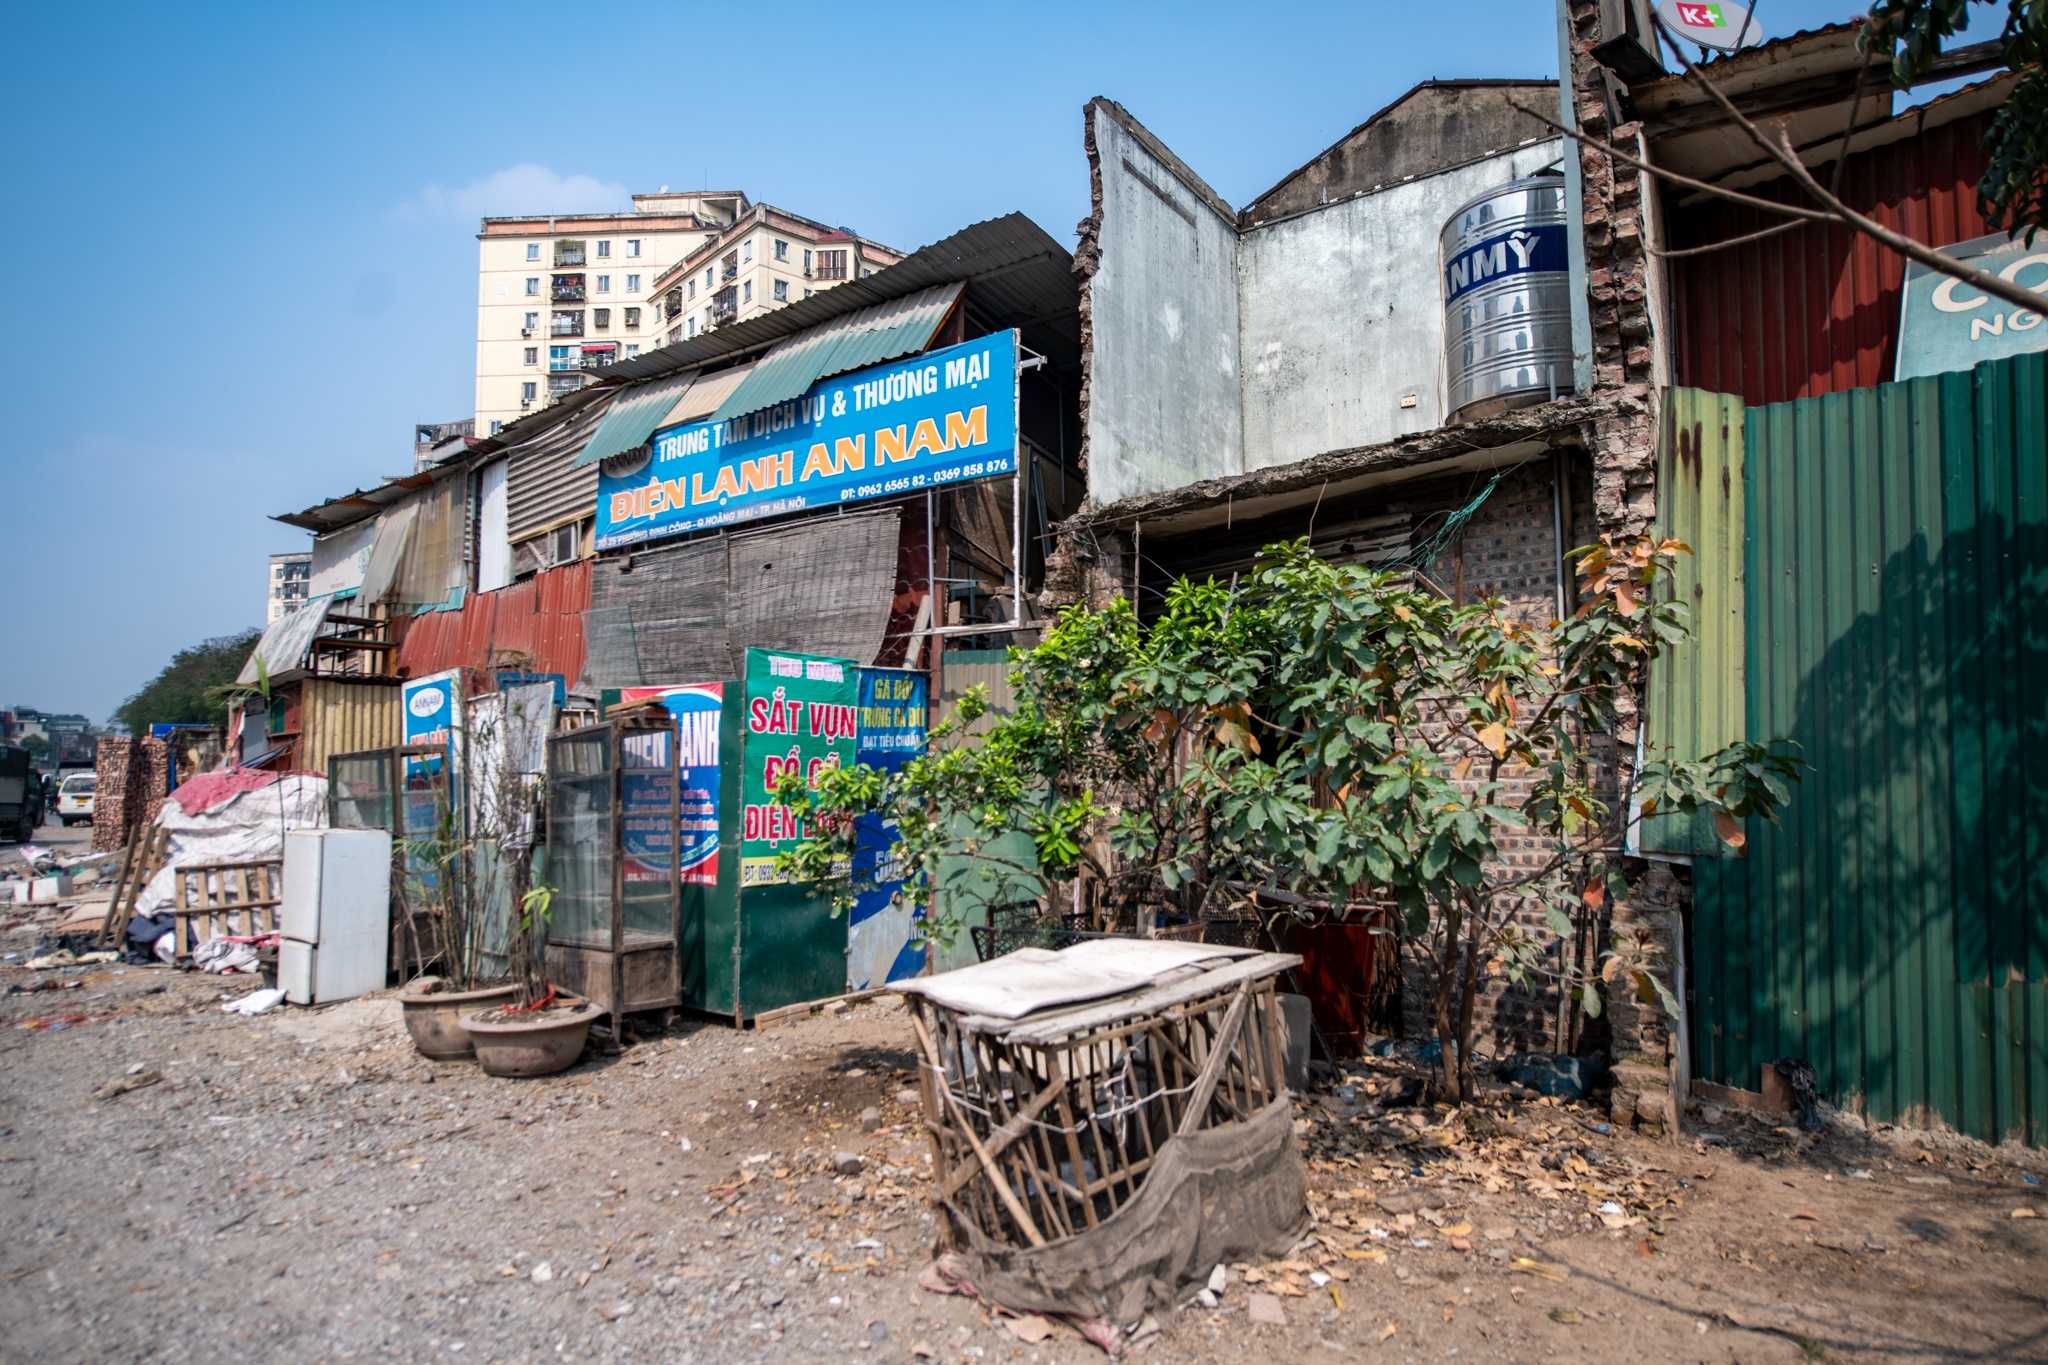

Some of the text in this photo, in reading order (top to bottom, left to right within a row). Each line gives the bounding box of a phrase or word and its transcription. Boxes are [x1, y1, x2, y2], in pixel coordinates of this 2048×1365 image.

[1681, 7, 1719, 24] K+
[658, 427, 709, 463] TRUNG
[754, 402, 795, 440] DỊCH
[801, 394, 826, 428] VỤ
[831, 389, 847, 418] &
[853, 365, 938, 412] THƯƠNG
[945, 350, 990, 389] MẠI
[609, 404, 988, 523] ĐIỆN LẠNH AN NAM
[840, 488, 856, 500] ĐT:
[857, 483, 882, 496] 0962
[884, 477, 910, 491] 6565
[911, 473, 925, 486] 82
[933, 467, 961, 483] 0369
[962, 462, 985, 477] 858
[986, 459, 1008, 473] 876
[737, 508, 754, 520] MAI
[773, 499, 787, 513] HÀ
[788, 496, 806, 510] NỘI
[768, 655, 845, 683] THU MUA
[874, 675, 891, 700] GÀ
[749, 686, 857, 745] SẮT VỤN
[670, 709, 722, 781] ẠNH
[744, 804, 797, 849] ĐIỆN
